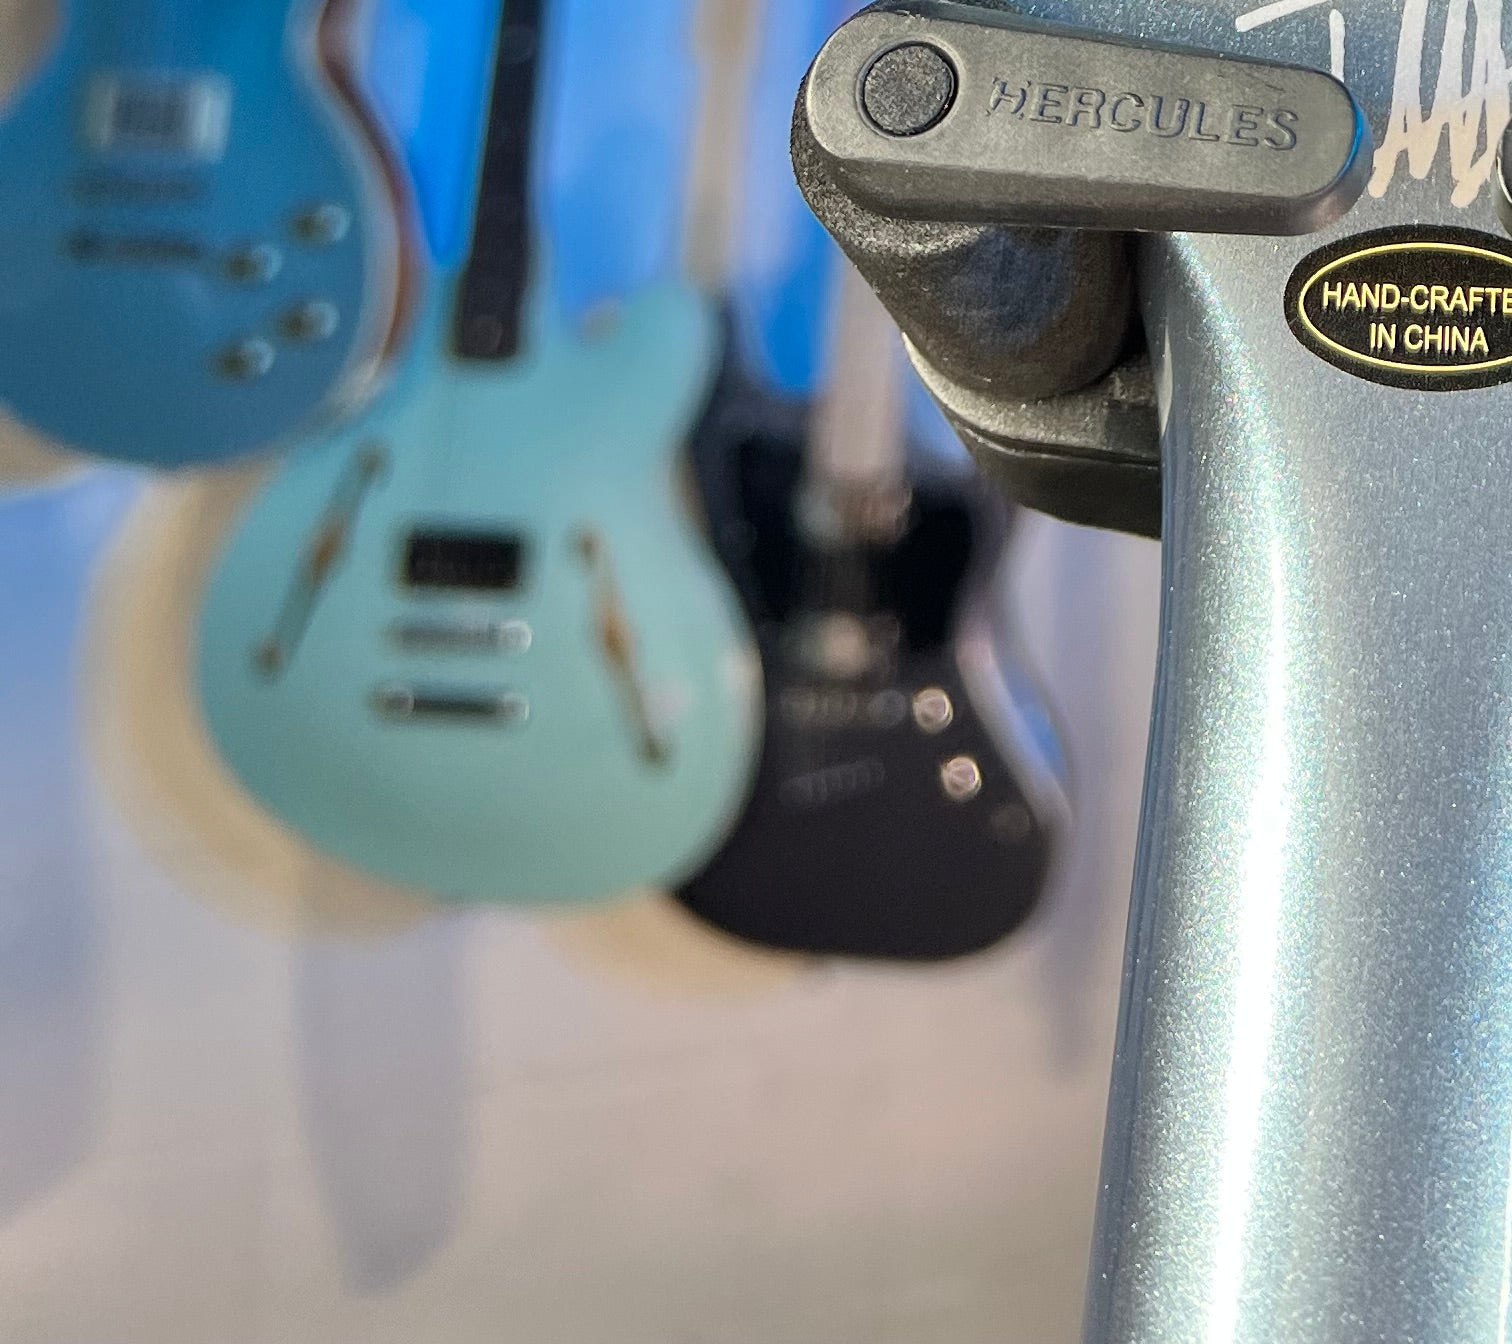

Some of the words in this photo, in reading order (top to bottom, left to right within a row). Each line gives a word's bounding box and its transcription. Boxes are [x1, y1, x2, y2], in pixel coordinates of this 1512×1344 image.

[988, 75, 1299, 151] HERCULES
[1369, 322, 1397, 350] IN
[1403, 322, 1490, 353] CHINA
